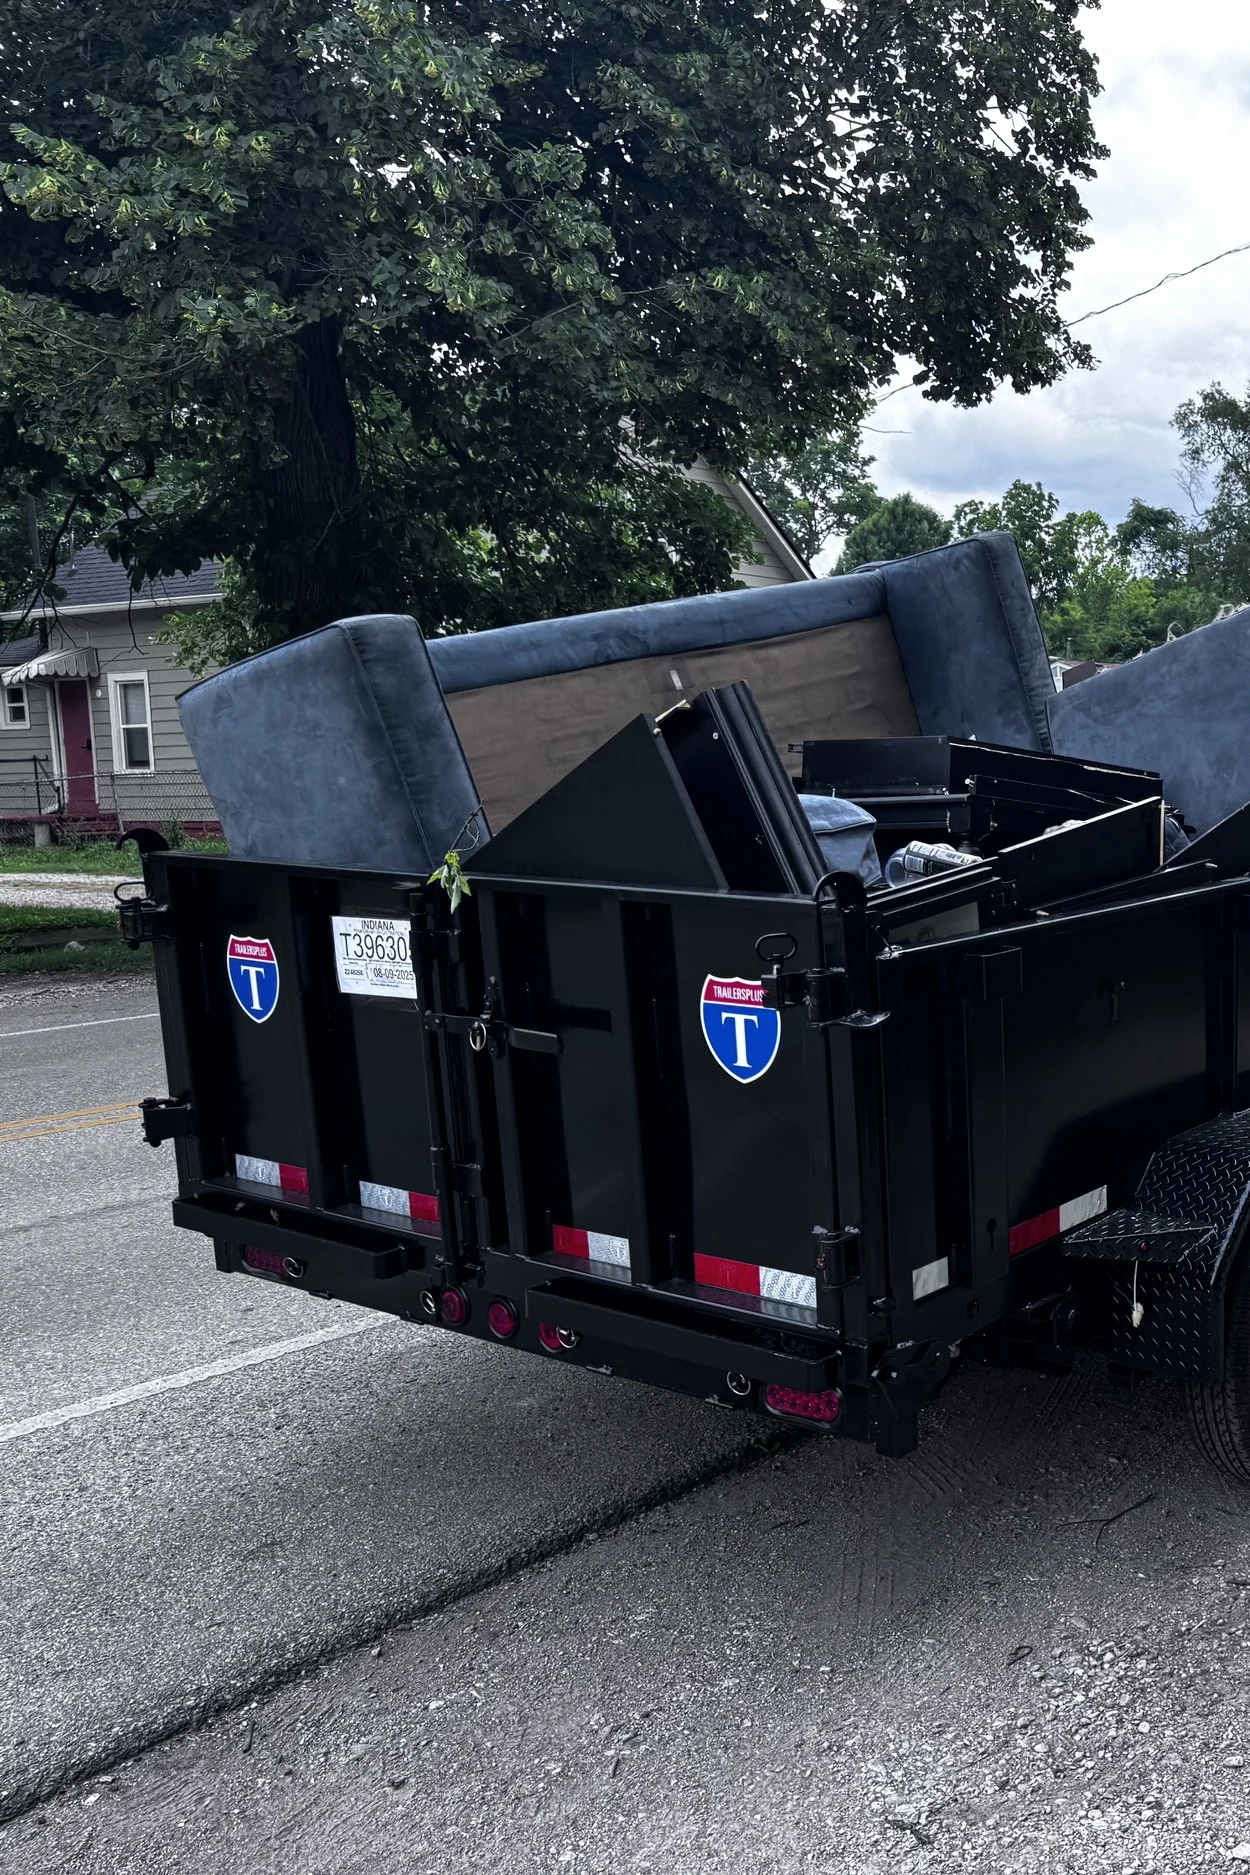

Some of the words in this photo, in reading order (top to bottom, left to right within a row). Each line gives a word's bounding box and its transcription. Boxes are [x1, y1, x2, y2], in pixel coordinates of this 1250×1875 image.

[361, 919, 395, 931] INDIANA
[234, 943, 268, 958] TRAILERSPLUS
[373, 967, 415, 981] 08-09-2025
[240, 965, 266, 1011] T
[712, 985, 764, 1003] TRAILERSPLUS
[721, 1011, 759, 1068] T
